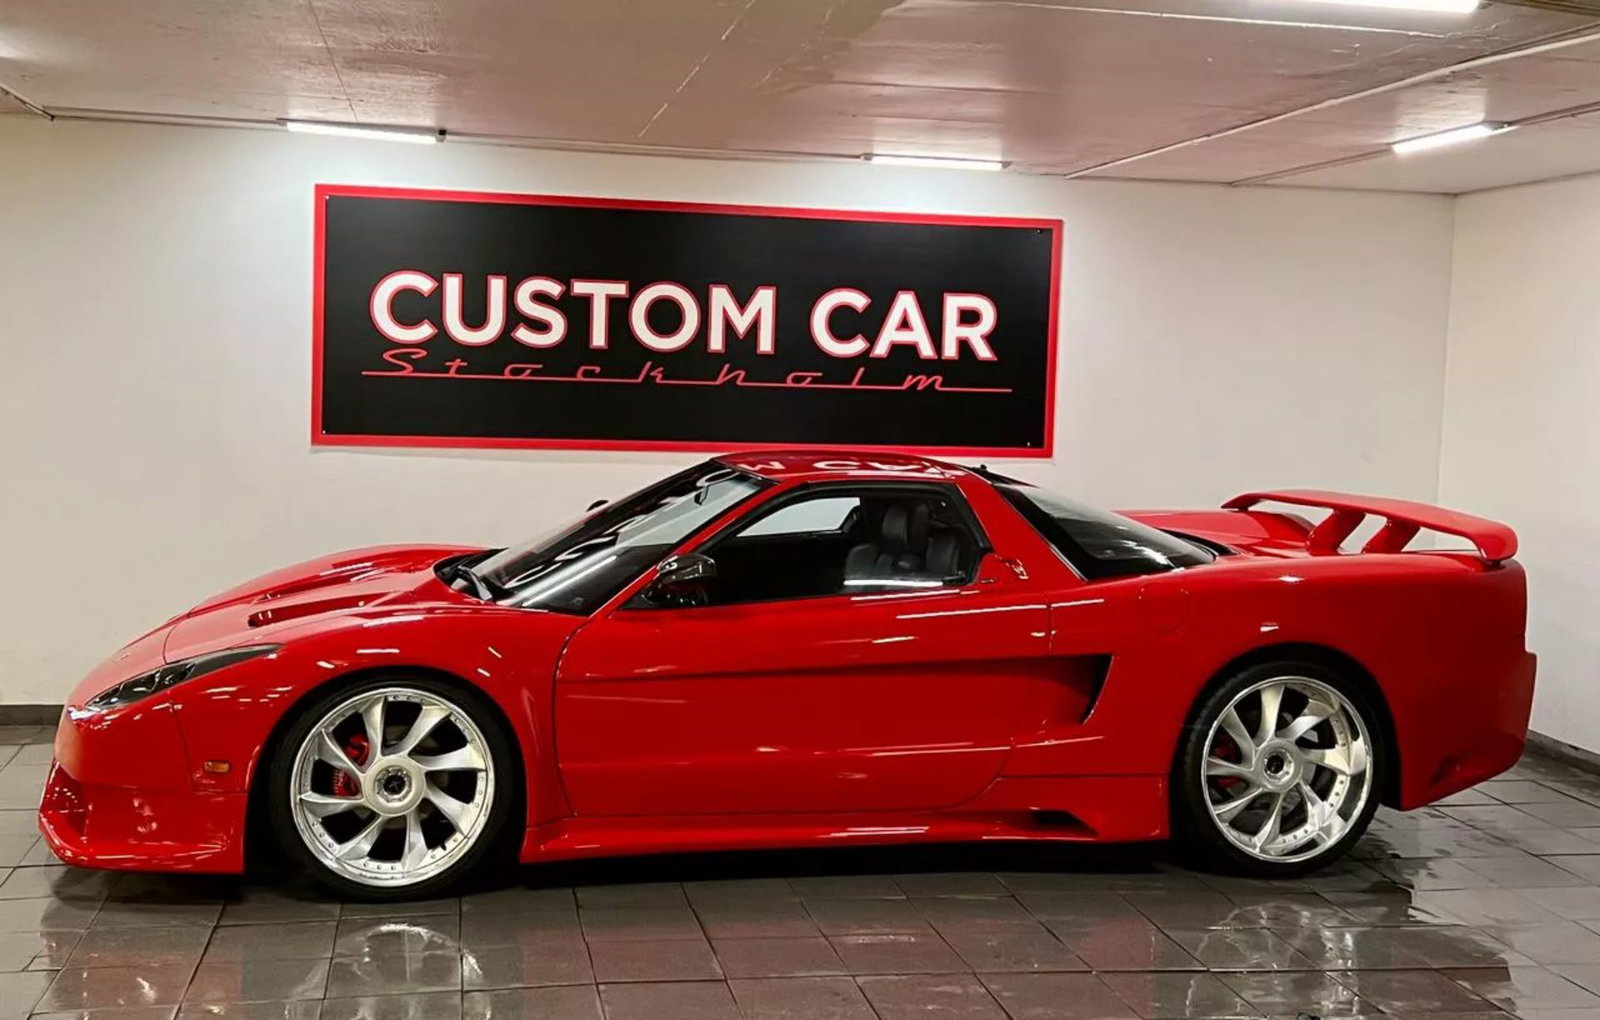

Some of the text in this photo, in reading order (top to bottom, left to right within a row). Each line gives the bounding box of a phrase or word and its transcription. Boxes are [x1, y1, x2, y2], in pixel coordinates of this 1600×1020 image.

[369, 269, 998, 361] CUSTOM CAR
[361, 347, 1012, 393] Stockholm
